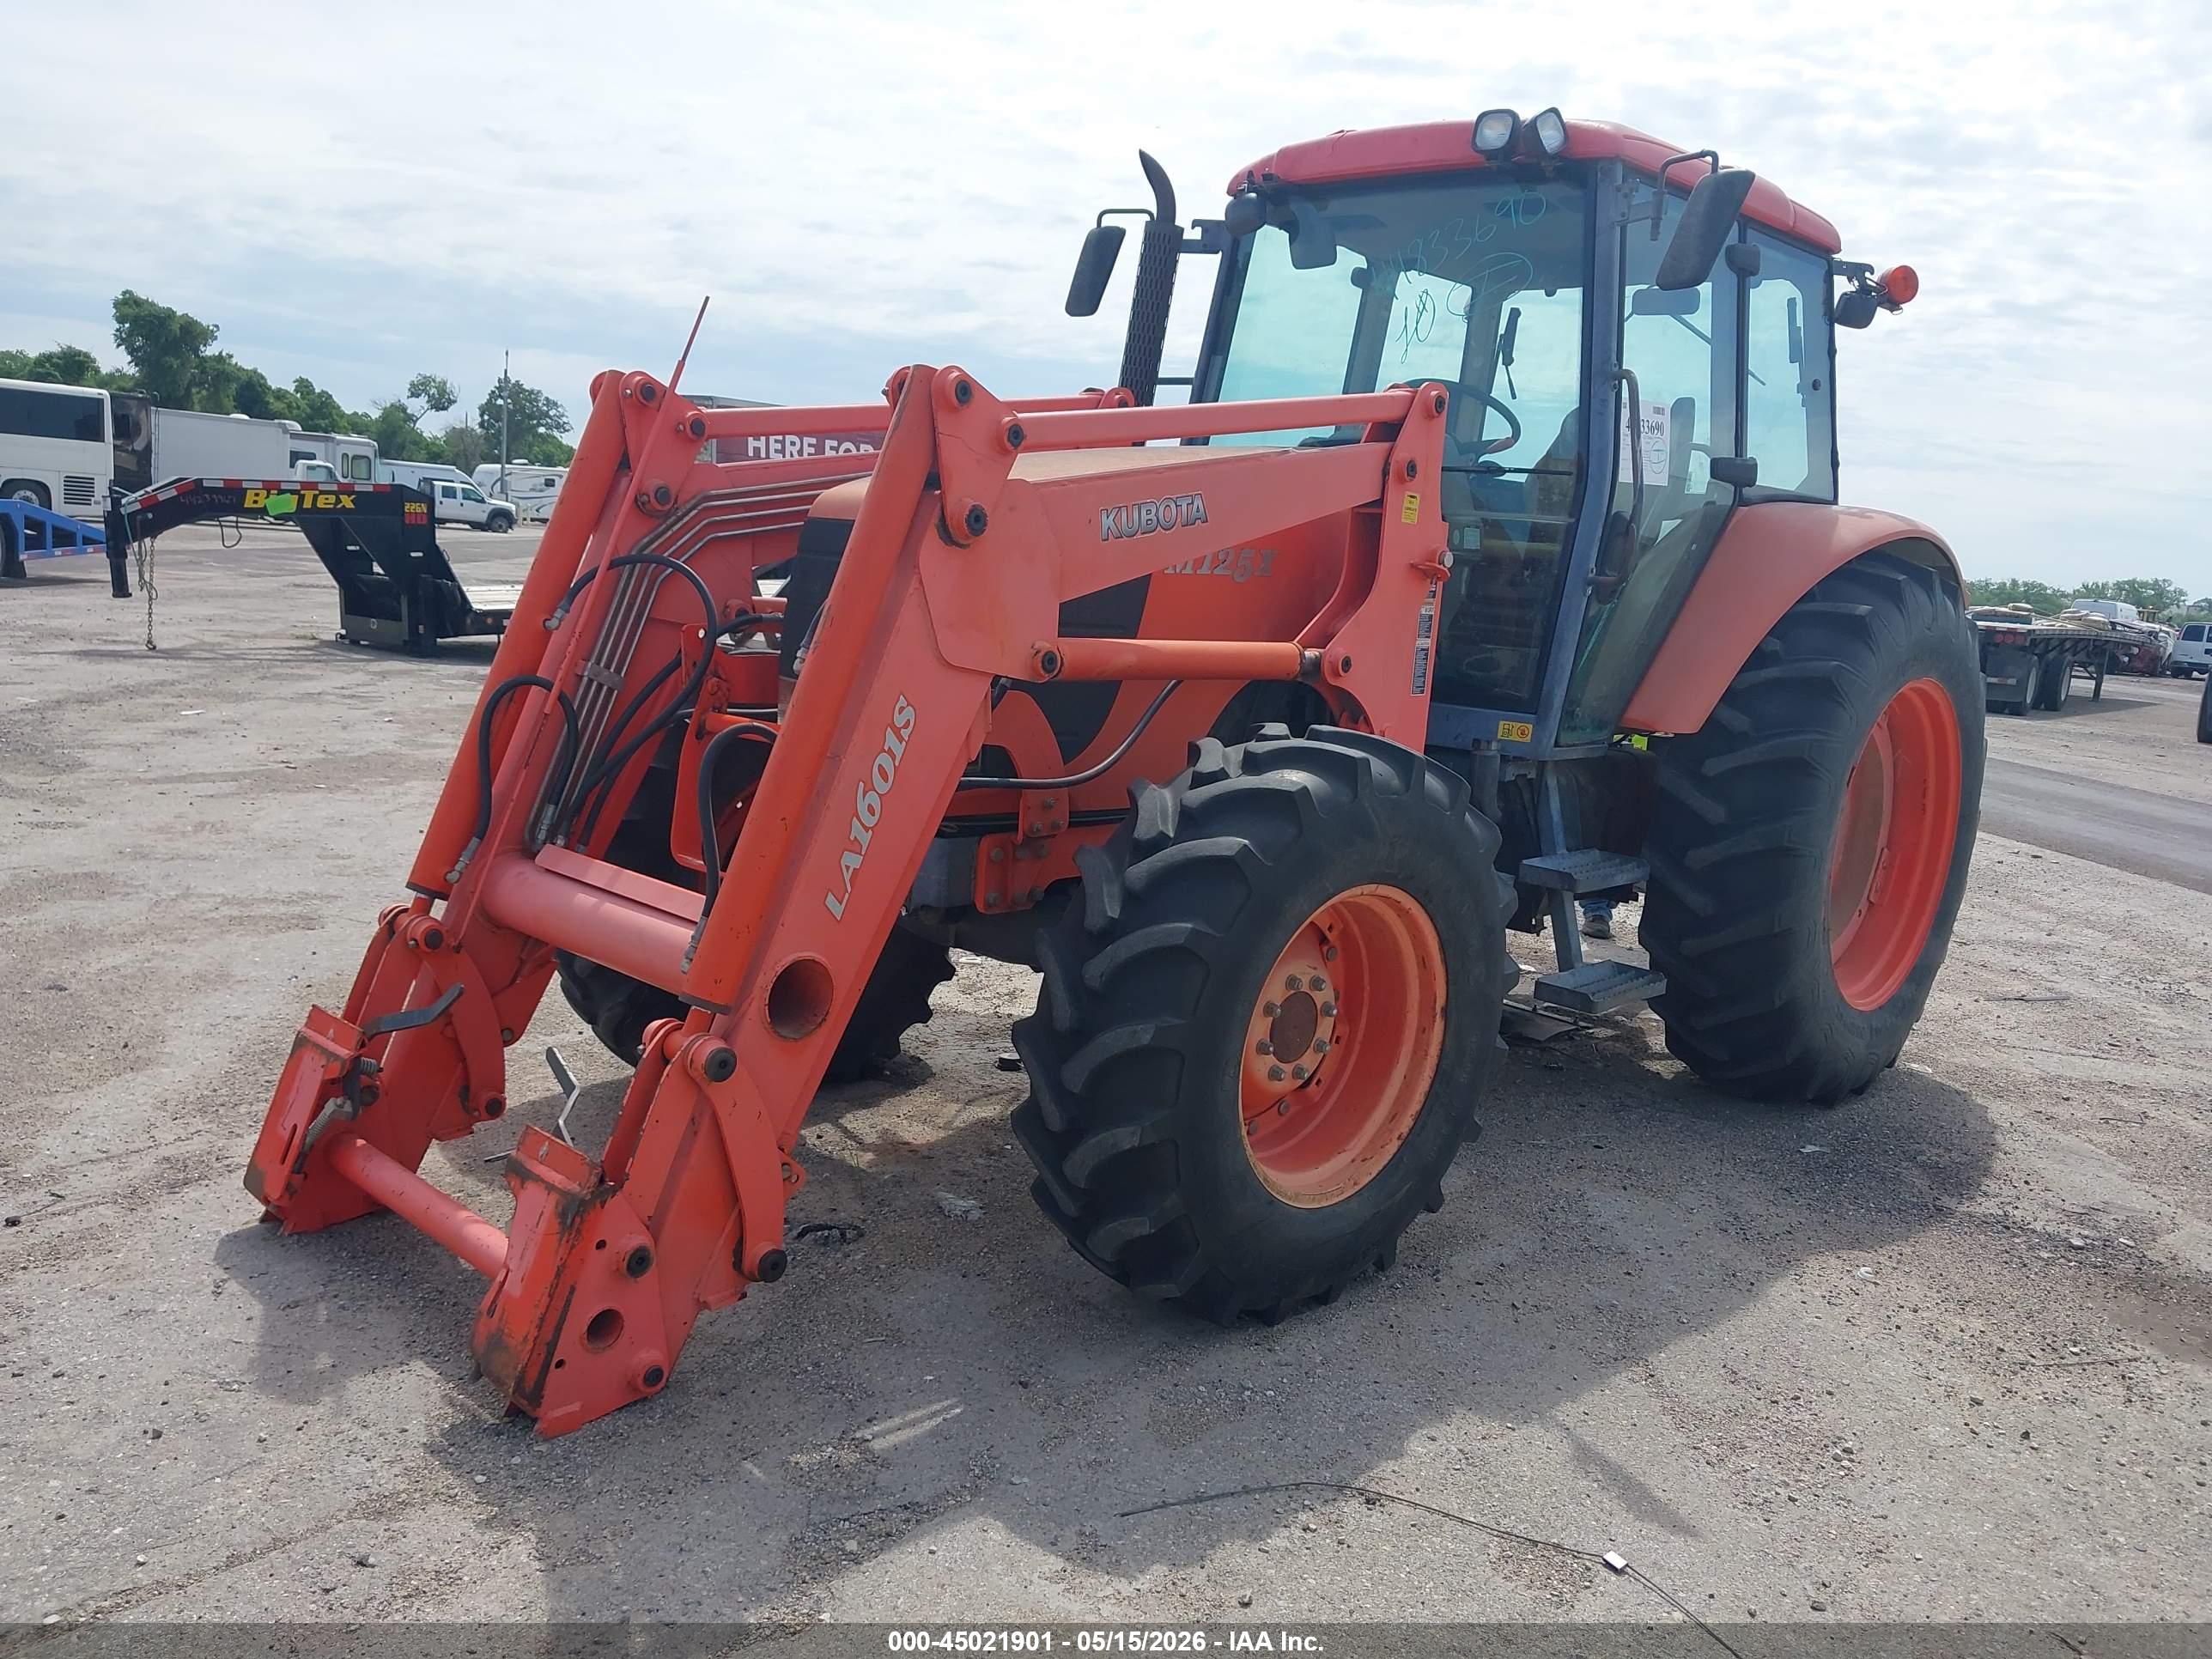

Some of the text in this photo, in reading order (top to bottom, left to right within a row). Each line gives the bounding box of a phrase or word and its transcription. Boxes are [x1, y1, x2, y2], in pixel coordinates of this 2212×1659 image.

[1625, 417, 1665, 437] 433690
[748, 434, 817, 459] HERE
[244, 489, 356, 509] BTex
[404, 501, 427, 514] 226N
[1100, 492, 1208, 542] KUBOTA
[825, 694, 916, 921] LA1601S
